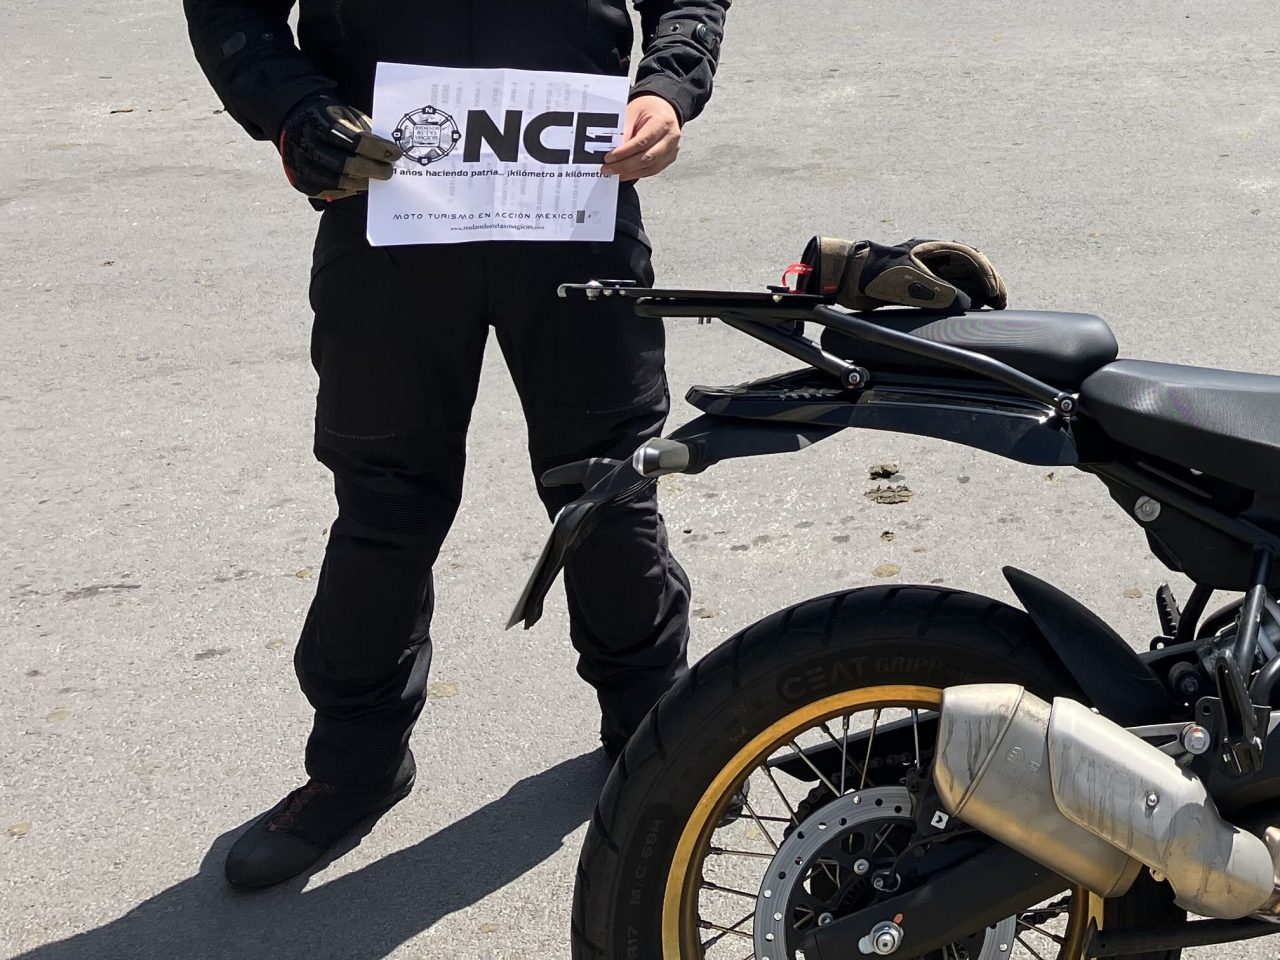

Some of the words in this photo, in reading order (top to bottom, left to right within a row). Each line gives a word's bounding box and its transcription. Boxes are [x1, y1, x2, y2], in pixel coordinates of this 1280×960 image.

[462, 109, 620, 165] NCE
[399, 168, 423, 176] años
[425, 169, 469, 177] haciendo
[781, 655, 869, 699] CEAT
